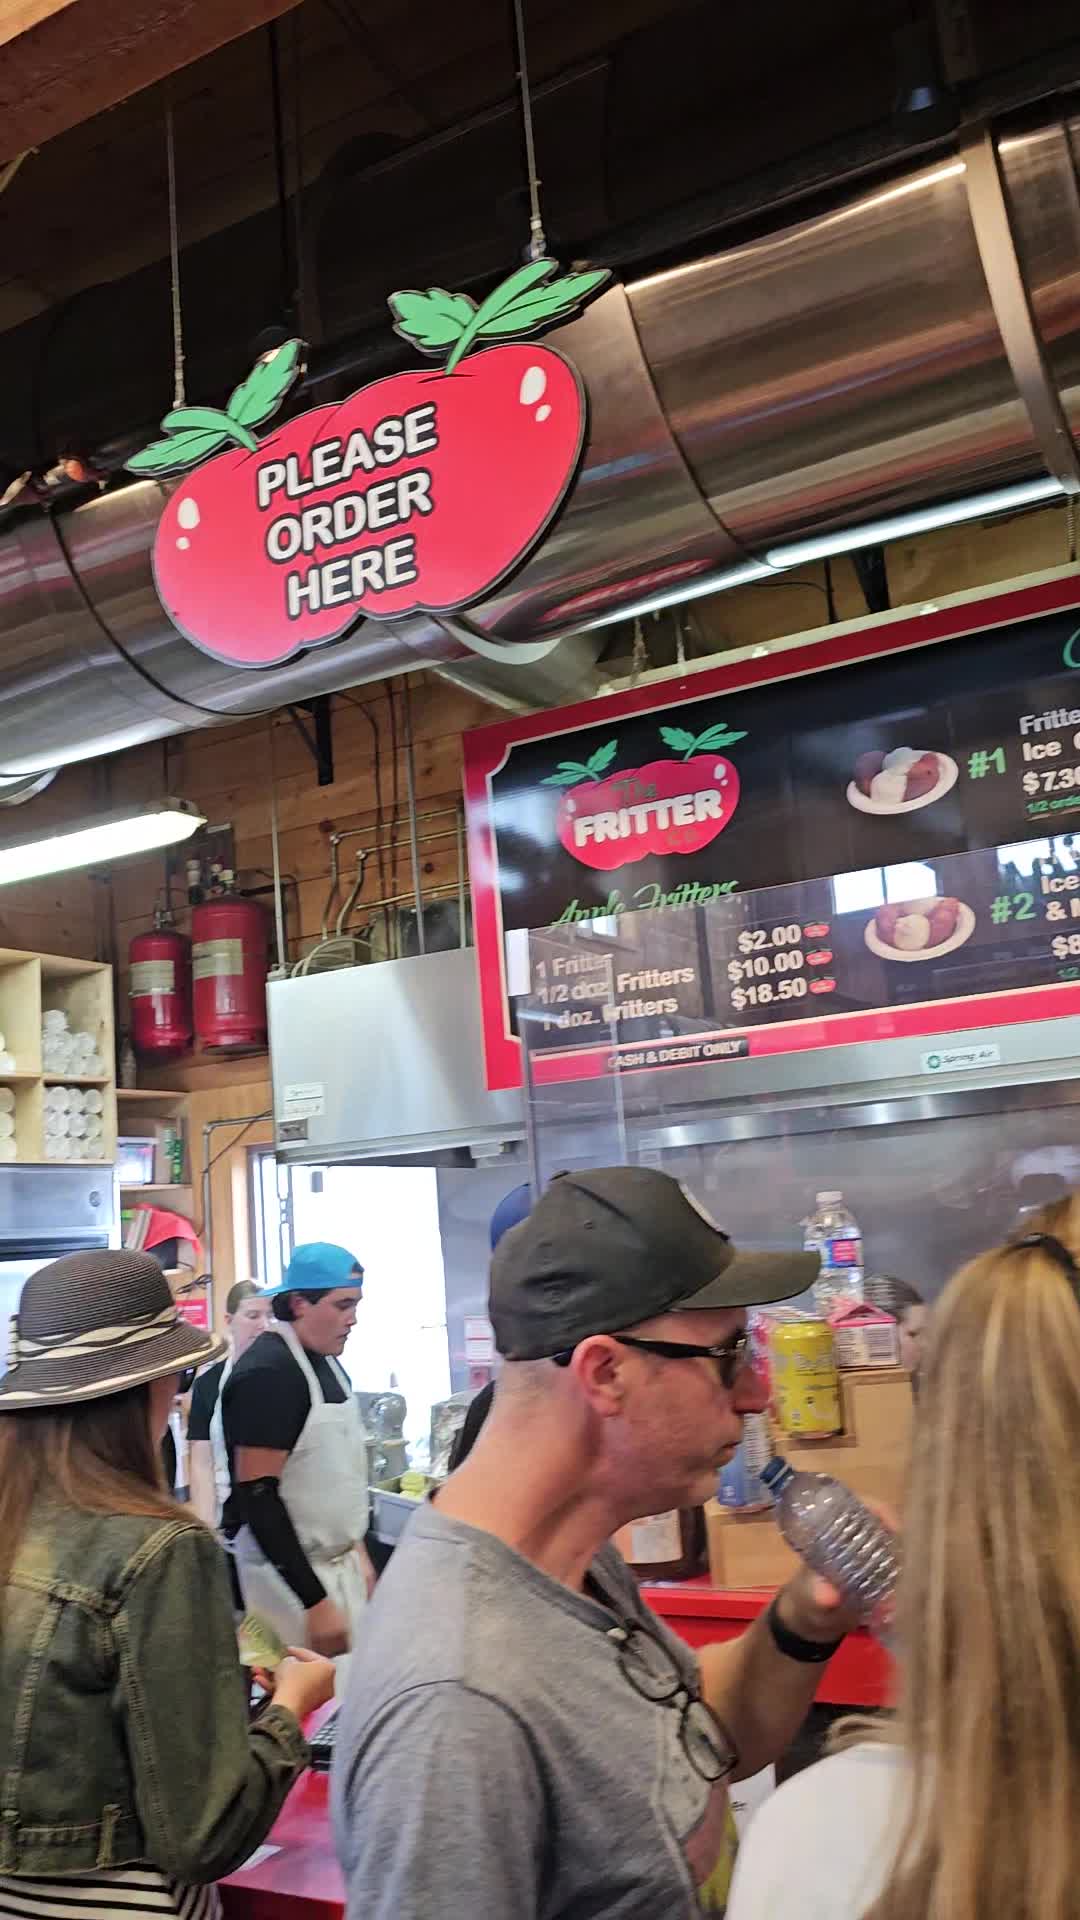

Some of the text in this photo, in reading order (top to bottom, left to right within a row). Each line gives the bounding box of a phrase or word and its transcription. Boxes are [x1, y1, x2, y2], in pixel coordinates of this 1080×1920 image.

[256, 402, 438, 509] PLEASE
[265, 471, 434, 563] ORDER
[285, 536, 418, 619] HERE
[967, 746, 1006, 780] #1
[1022, 741, 1062, 762] Ice
[573, 789, 724, 847] FRITTER
[1041, 875, 1080, 895] Ice
[990, 892, 1037, 925] #2
[1045, 901, 1067, 921] &
[738, 924, 801, 954] $2.00
[535, 961, 546, 978] 1
[616, 967, 695, 994] Fritters
[727, 950, 804, 984] $10.00
[731, 977, 807, 1011] $18.50
[608, 1041, 741, 1068] CASH & DEBIT ONLY
